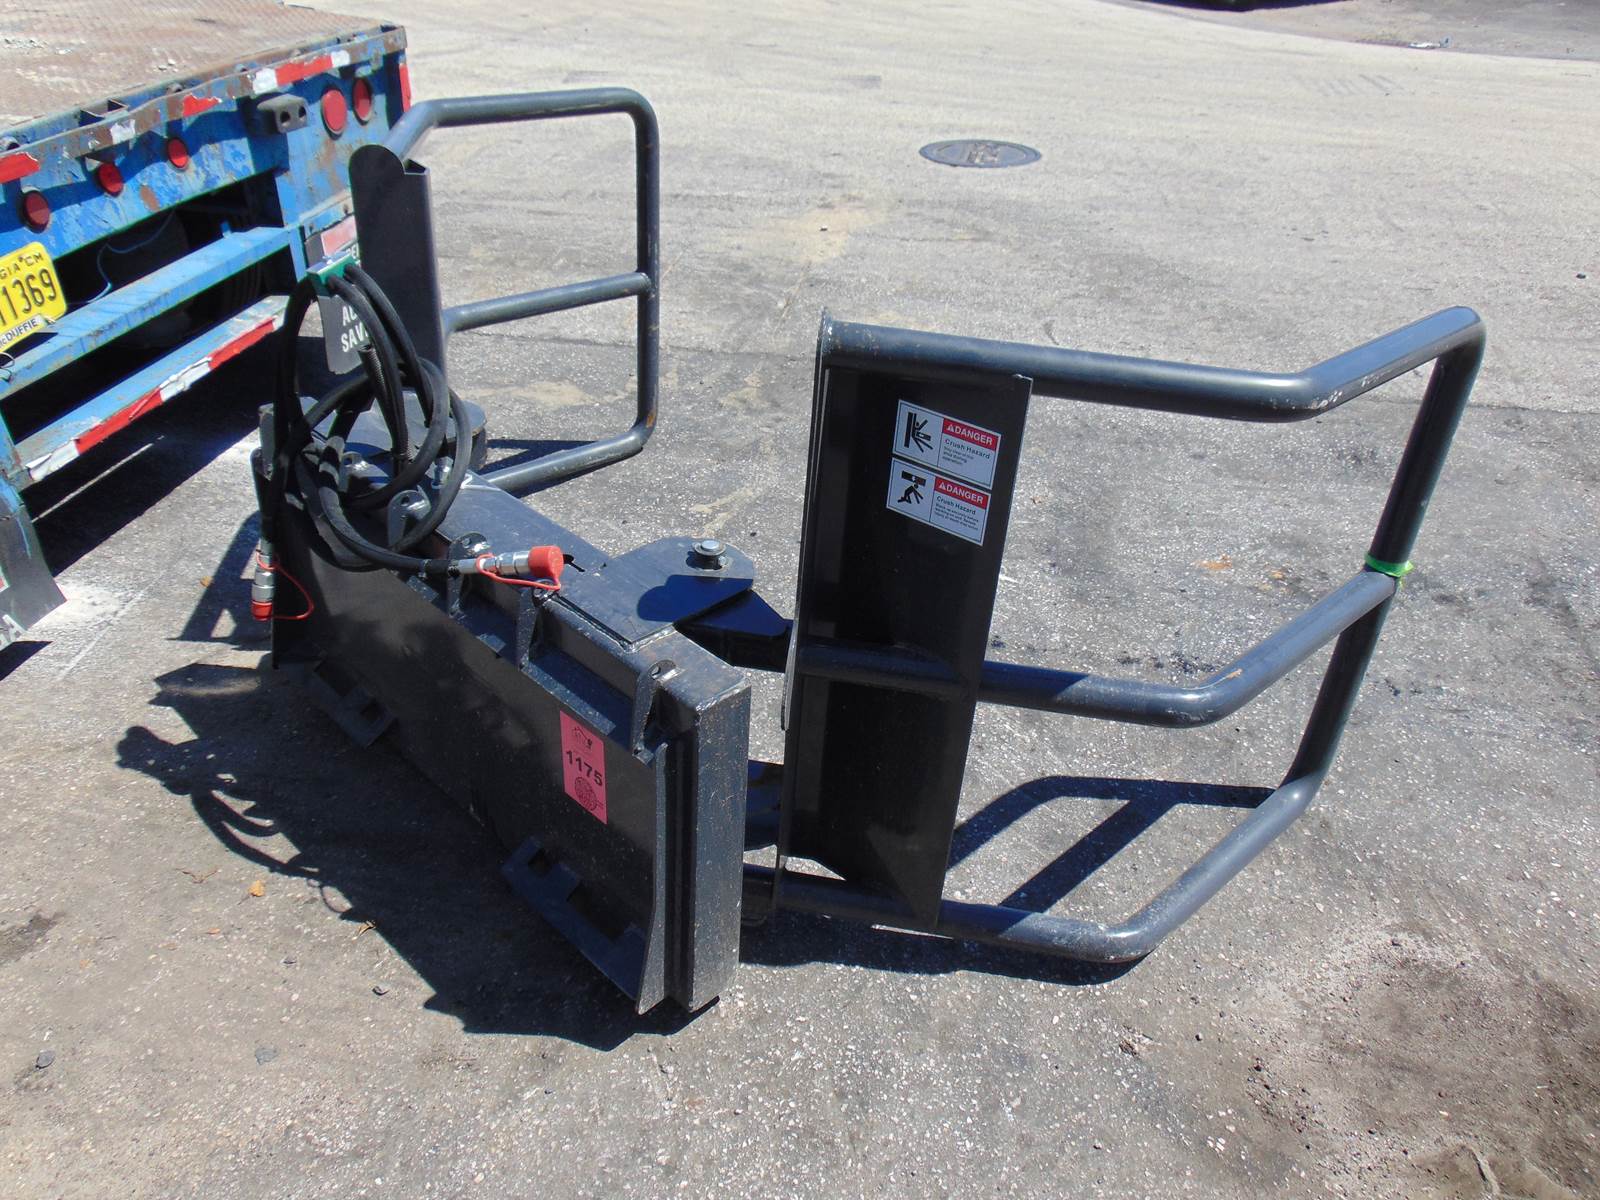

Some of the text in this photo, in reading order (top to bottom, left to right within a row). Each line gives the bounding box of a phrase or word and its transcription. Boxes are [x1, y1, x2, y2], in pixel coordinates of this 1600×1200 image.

[954, 425, 993, 446] DANGER
[945, 438, 966, 451] Crush
[966, 446, 991, 460] Hazard
[936, 495, 955, 507] Crush
[955, 503, 977, 515] Hazard
[946, 484, 984, 505] DANGER
[566, 750, 603, 786] 1175
